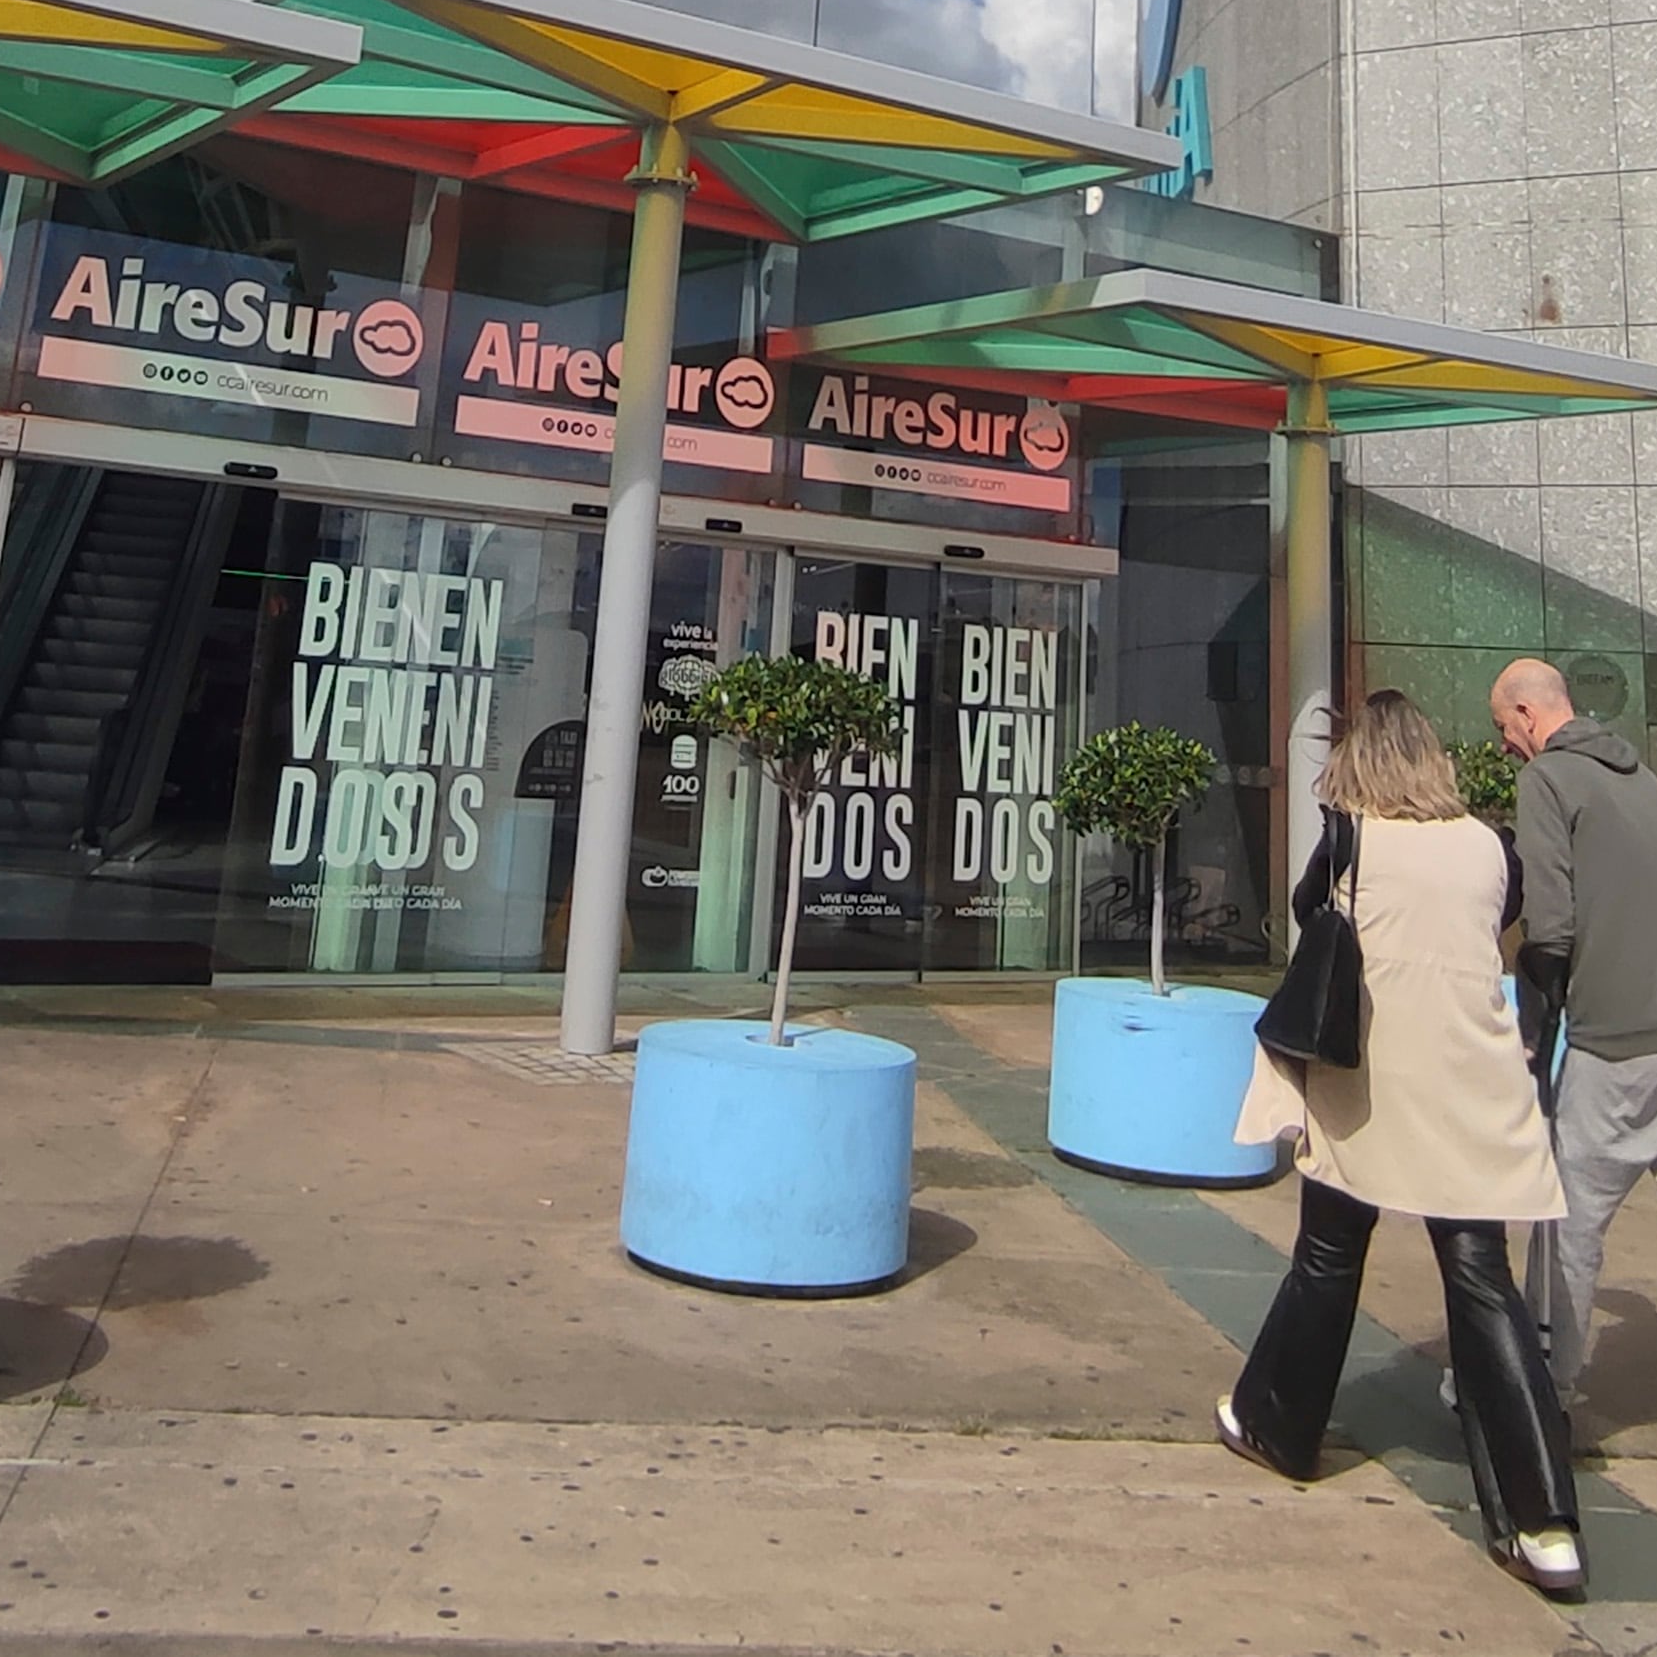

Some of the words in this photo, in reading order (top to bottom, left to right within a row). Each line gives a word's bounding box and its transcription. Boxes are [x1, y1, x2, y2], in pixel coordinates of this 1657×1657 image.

[50, 255, 353, 359] AireSur
[217, 371, 329, 403] ccairesur.com
[808, 375, 1018, 457] AireSur
[670, 620, 702, 638] vive
[960, 624, 1058, 711] BIEN
[662, 775, 700, 794] 100
[957, 709, 1055, 796] VENI
[803, 792, 914, 881] DOS
[953, 797, 1055, 884] DOS
